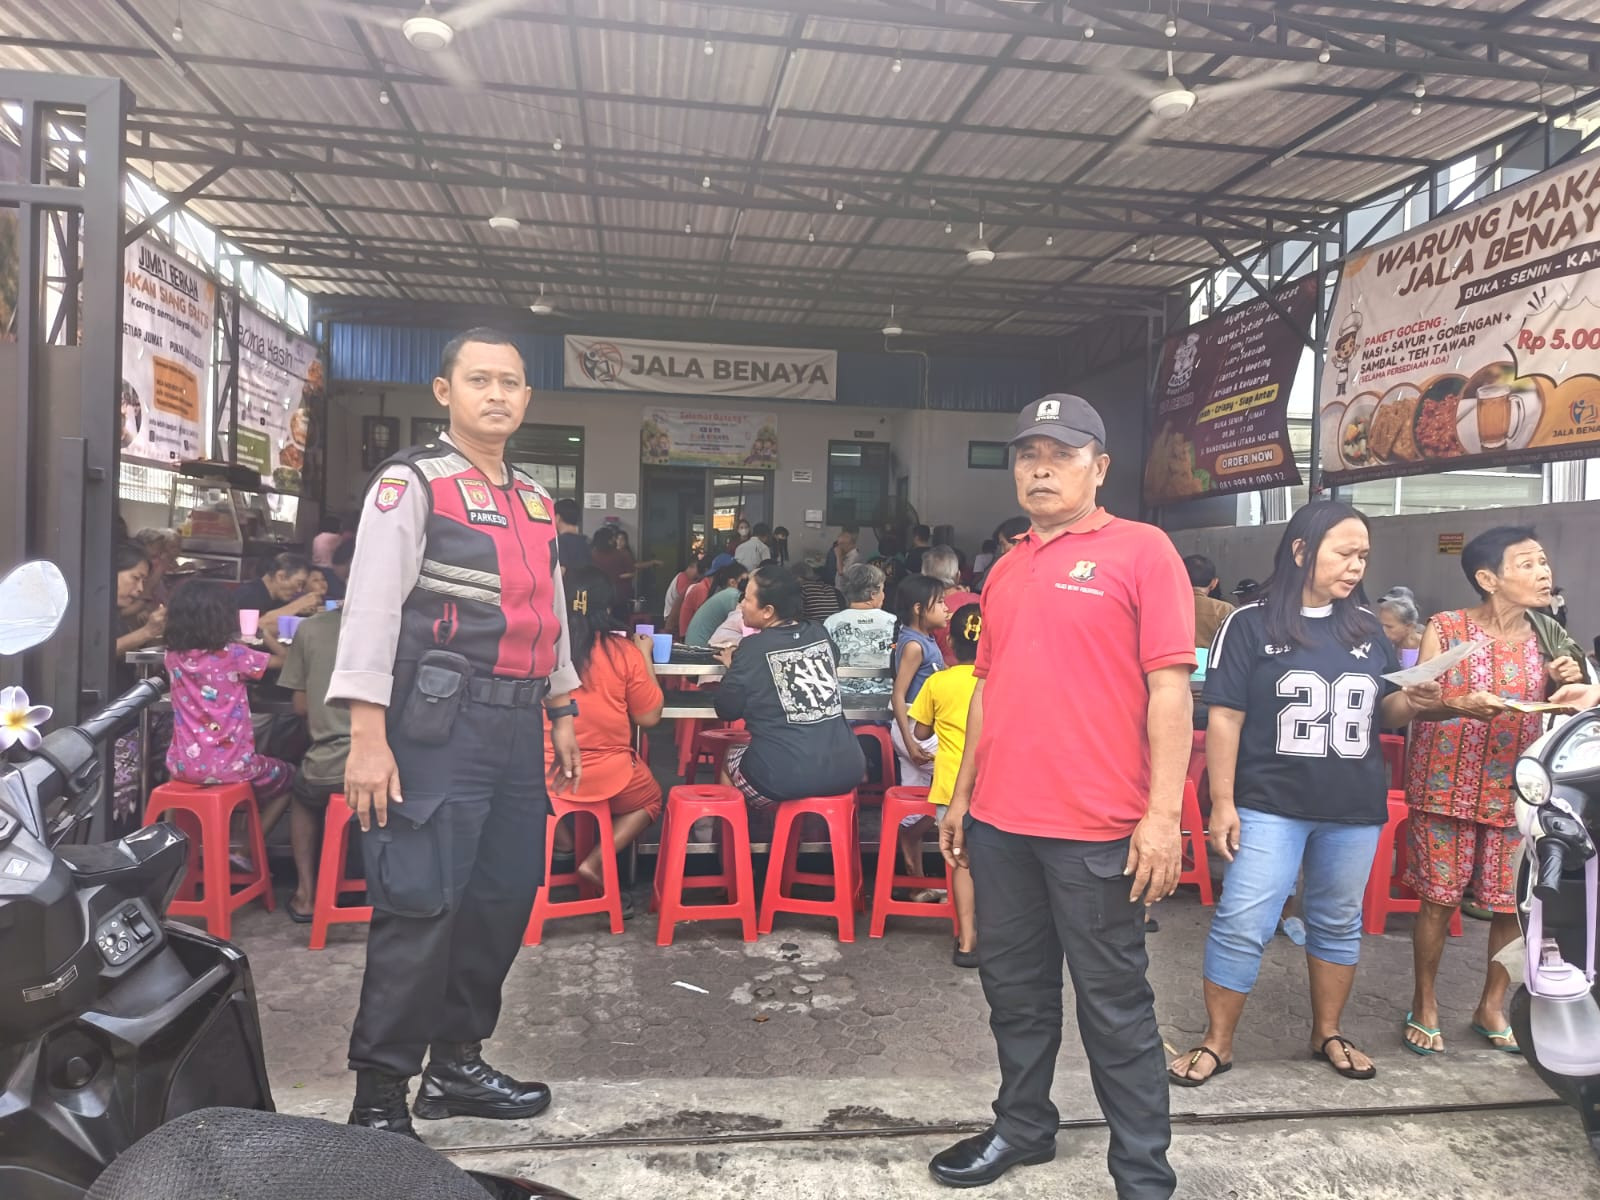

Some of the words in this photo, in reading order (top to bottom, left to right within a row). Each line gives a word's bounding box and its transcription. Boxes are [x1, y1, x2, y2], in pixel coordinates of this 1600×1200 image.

[1377, 207, 1501, 277] WARUNG
[1399, 249, 1474, 296] JALA
[1484, 203, 1600, 270] BENAY
[139, 246, 167, 278] JUMAT
[125, 270, 157, 299] AKAN
[159, 286, 186, 315] SIANG
[1464, 279, 1499, 300] BUKA
[1509, 261, 1551, 286] SENIN
[239, 324, 265, 354] erima
[267, 337, 293, 368] Kasih
[1361, 346, 1383, 361] NASI
[1391, 335, 1426, 353] SAYUR
[1436, 312, 1503, 340] GORENGAN
[1364, 329, 1396, 348] PAKET
[1396, 316, 1442, 337] GOCENG
[1517, 329, 1546, 355] Rp
[630, 354, 704, 379] JALA
[713, 359, 829, 385] BENAYA
[1358, 371, 1386, 385] (SELAMA
[1386, 361, 1429, 377] PERSEDIAAN
[1430, 354, 1450, 367] ADA)
[1360, 355, 1397, 375] SAMBAL
[1408, 347, 1429, 362] TEH
[1432, 335, 1476, 355] TAWAR
[1238, 437, 1256, 447] UTARA
[1552, 429, 1575, 438] JALA
[1222, 454, 1249, 469] ORDER
[1251, 450, 1274, 462] NOW
[1276, 669, 1379, 759] 28
